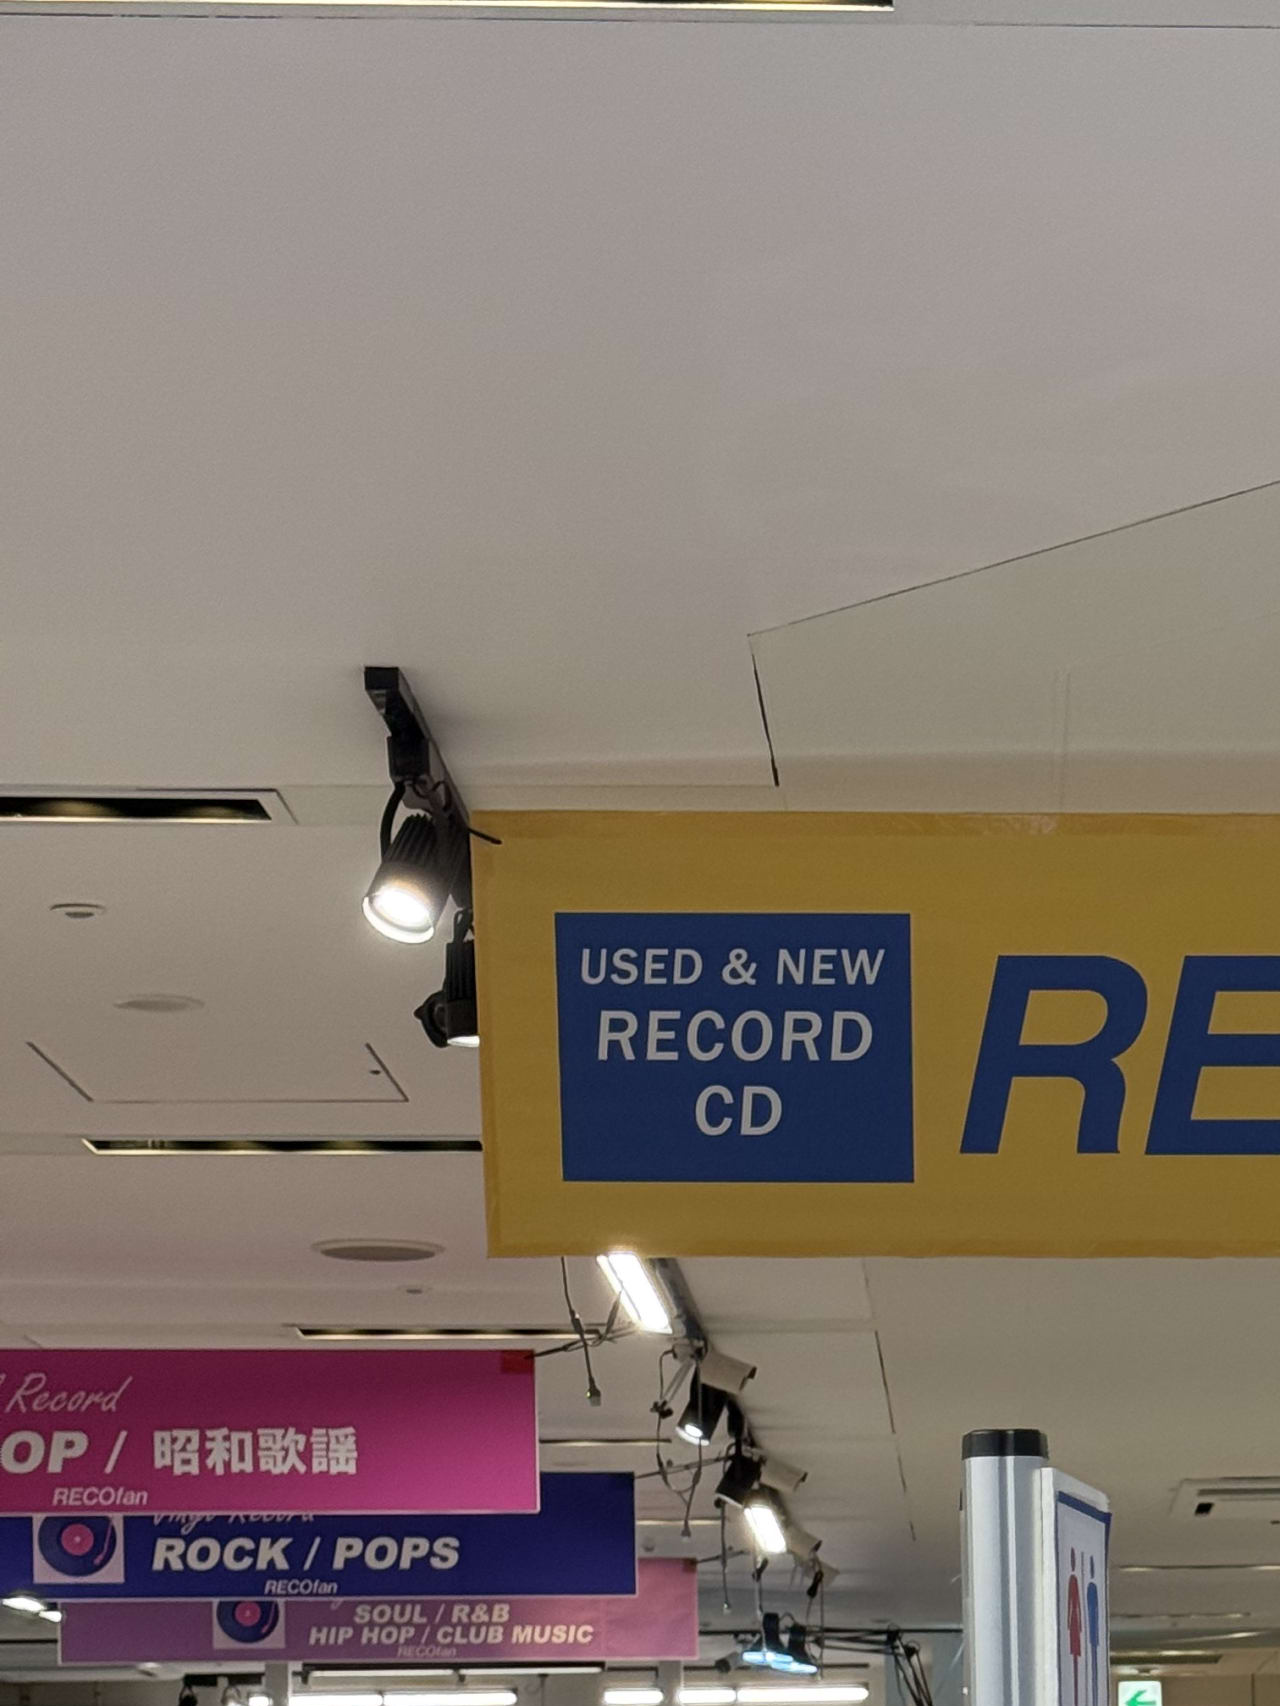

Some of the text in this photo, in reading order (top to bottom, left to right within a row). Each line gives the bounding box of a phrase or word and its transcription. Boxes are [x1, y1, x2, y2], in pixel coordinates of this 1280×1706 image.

[580, 948, 886, 986] USED & NEW
[597, 1010, 875, 1063] RECORD
[693, 1084, 784, 1137] CD
[4, 1372, 133, 1414] Record
[105, 1430, 128, 1475] /
[152, 1426, 358, 1476] 昭和歌謡
[52, 1486, 149, 1507] RECOfan
[151, 1536, 461, 1572] ROCK / POPS
[264, 1579, 339, 1596] RECOfan
[353, 1603, 428, 1625] SOUL
[450, 1602, 511, 1624] R&B
[308, 1626, 354, 1646] HIP
[360, 1626, 416, 1645] HOP
[436, 1625, 505, 1645] CLUB
[511, 1624, 595, 1644] MUSIC
